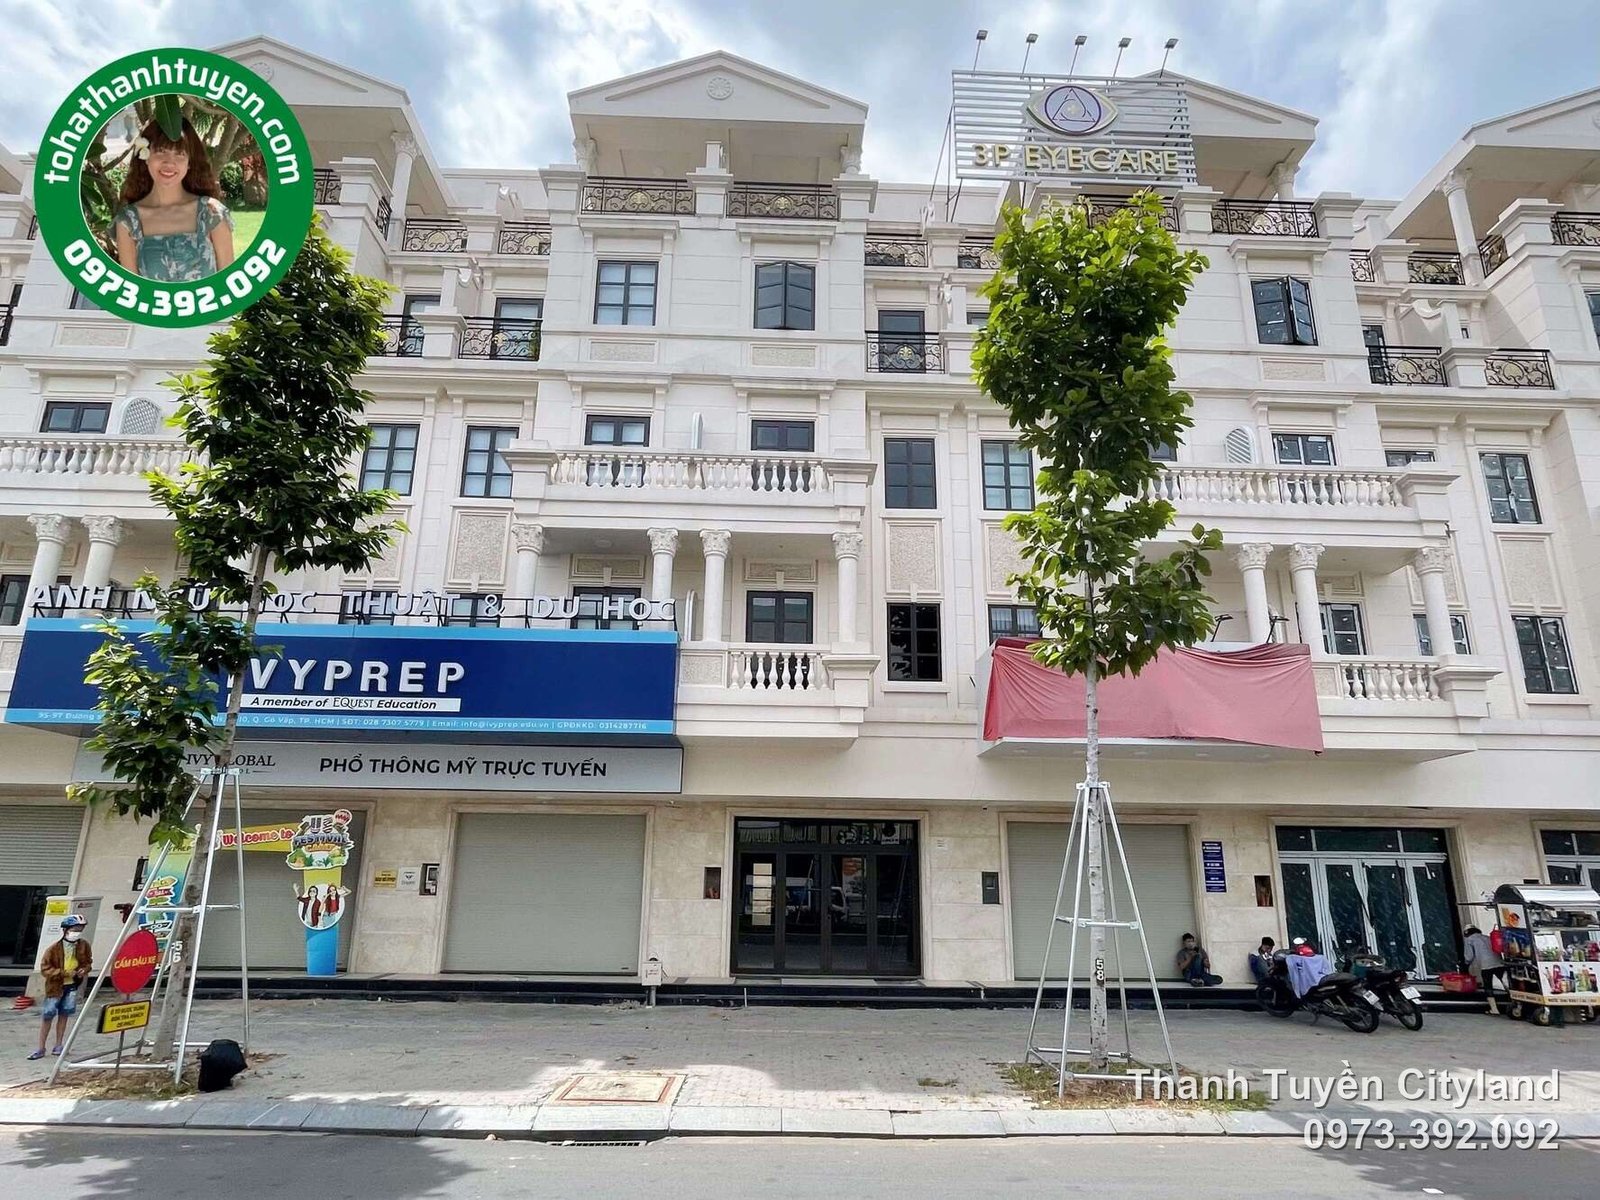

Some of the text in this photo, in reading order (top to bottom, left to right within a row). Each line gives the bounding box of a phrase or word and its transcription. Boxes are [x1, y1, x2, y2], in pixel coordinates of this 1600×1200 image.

[972, 143, 1180, 175] 3P EYECARE
[30, 584, 112, 609] ANH
[342, 588, 461, 623] THUẬT
[484, 594, 505, 618] &
[532, 594, 581, 619] DU
[602, 596, 676, 627] HỌC
[250, 696, 437, 710] A member of EQUEST Education
[363, 718, 379, 726] 028
[319, 753, 608, 780] PHỔ THÔNG MỸ TRỰC TUYẾN
